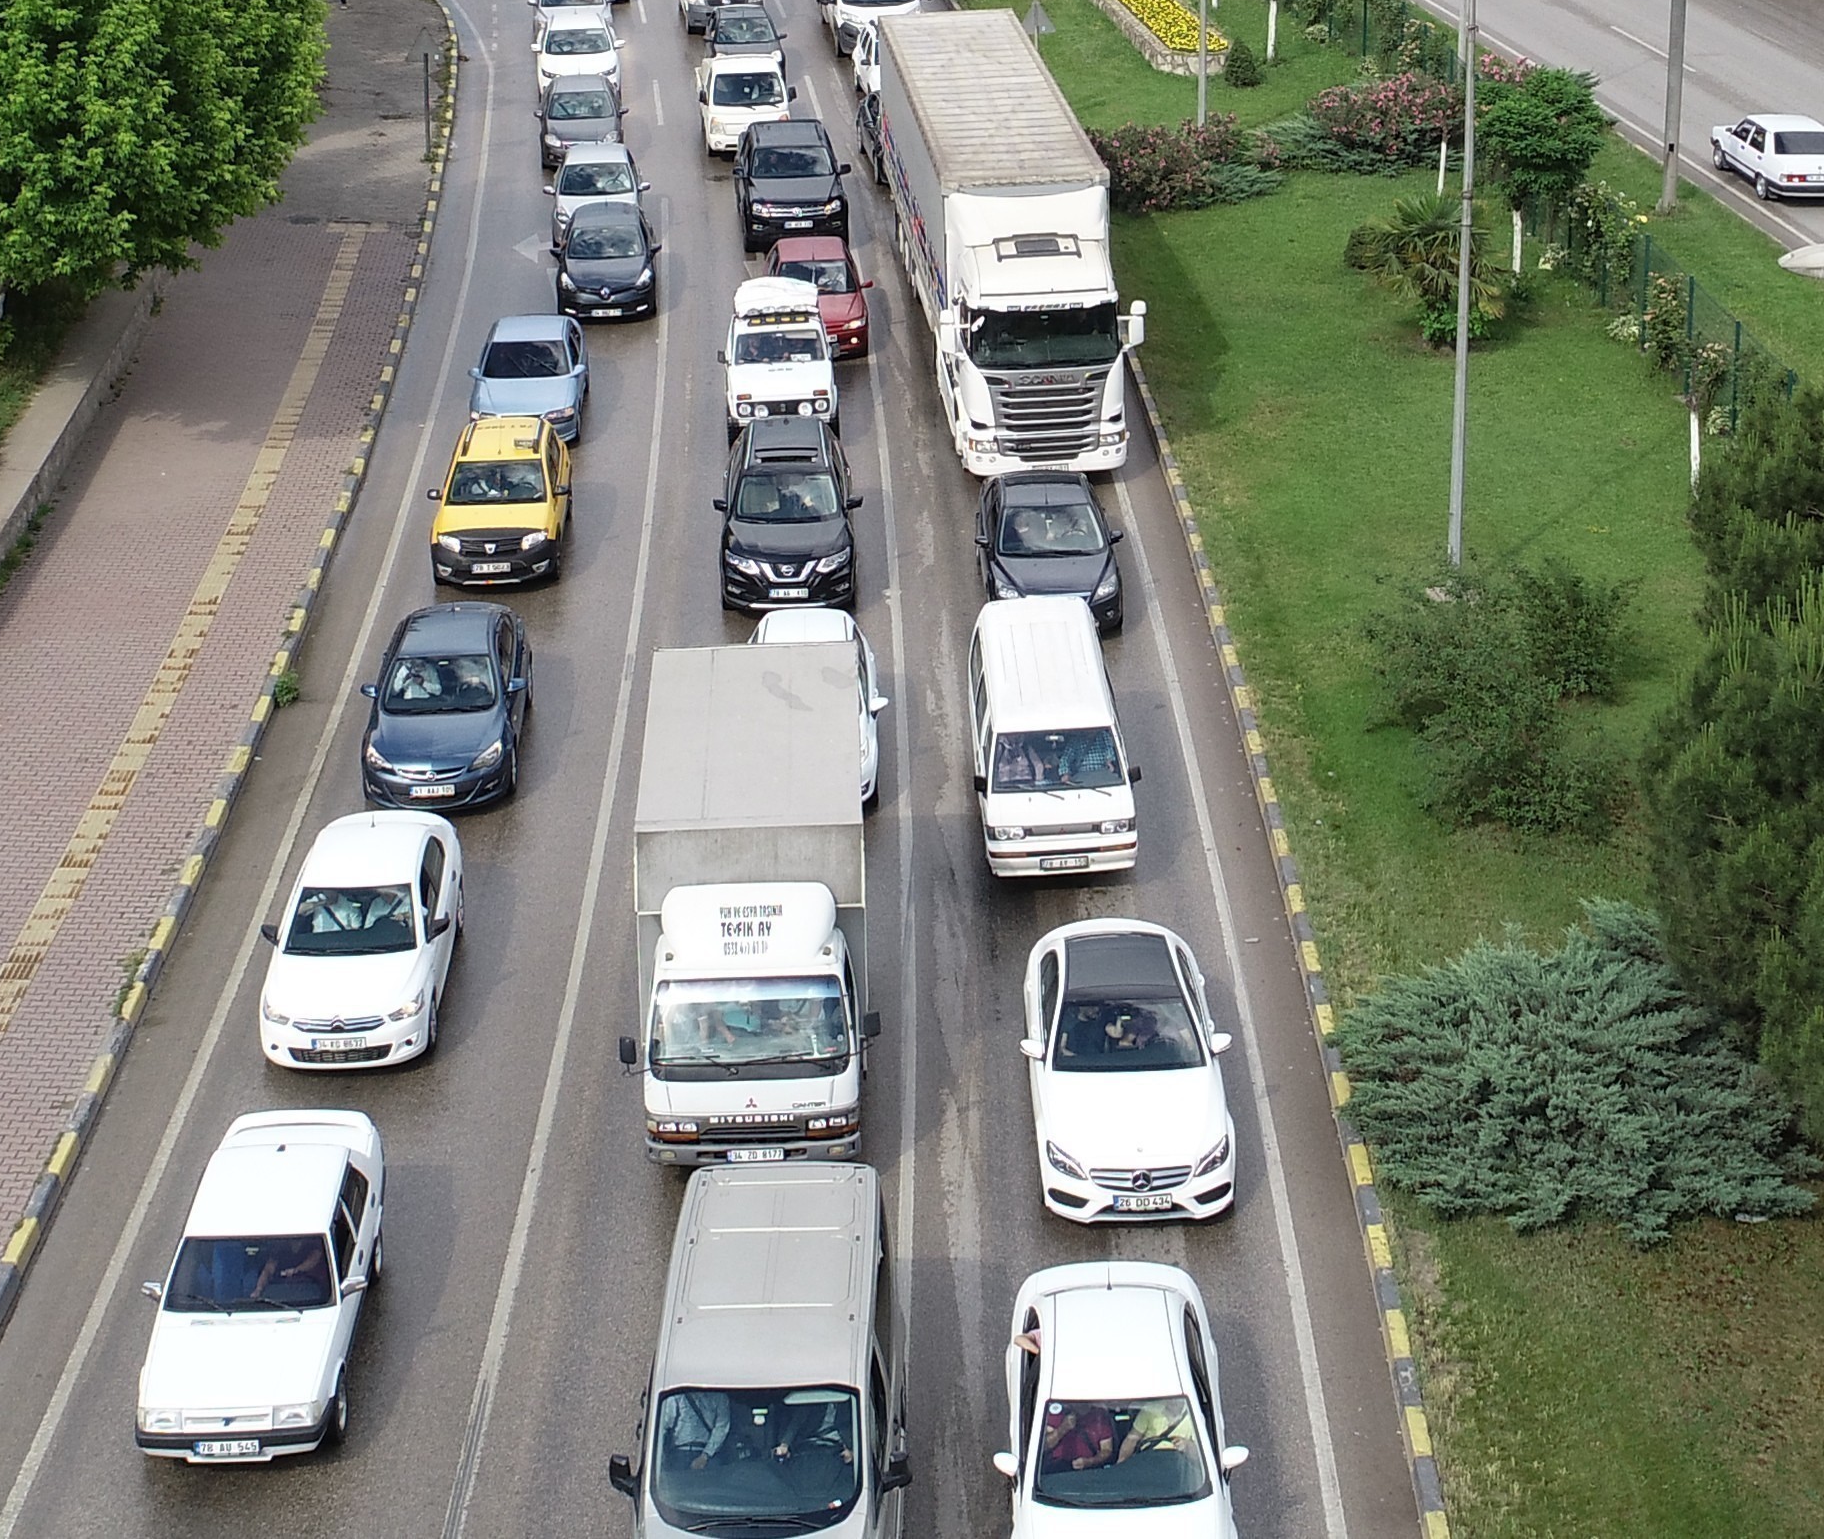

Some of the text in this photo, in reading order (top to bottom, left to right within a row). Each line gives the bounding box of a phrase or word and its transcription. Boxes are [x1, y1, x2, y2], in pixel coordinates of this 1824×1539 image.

[709, 1114, 795, 1124] MITSUBISHI
[1119, 1196, 1170, 1208] 26 DD 434
[236, 1441, 258, 1452] 545
